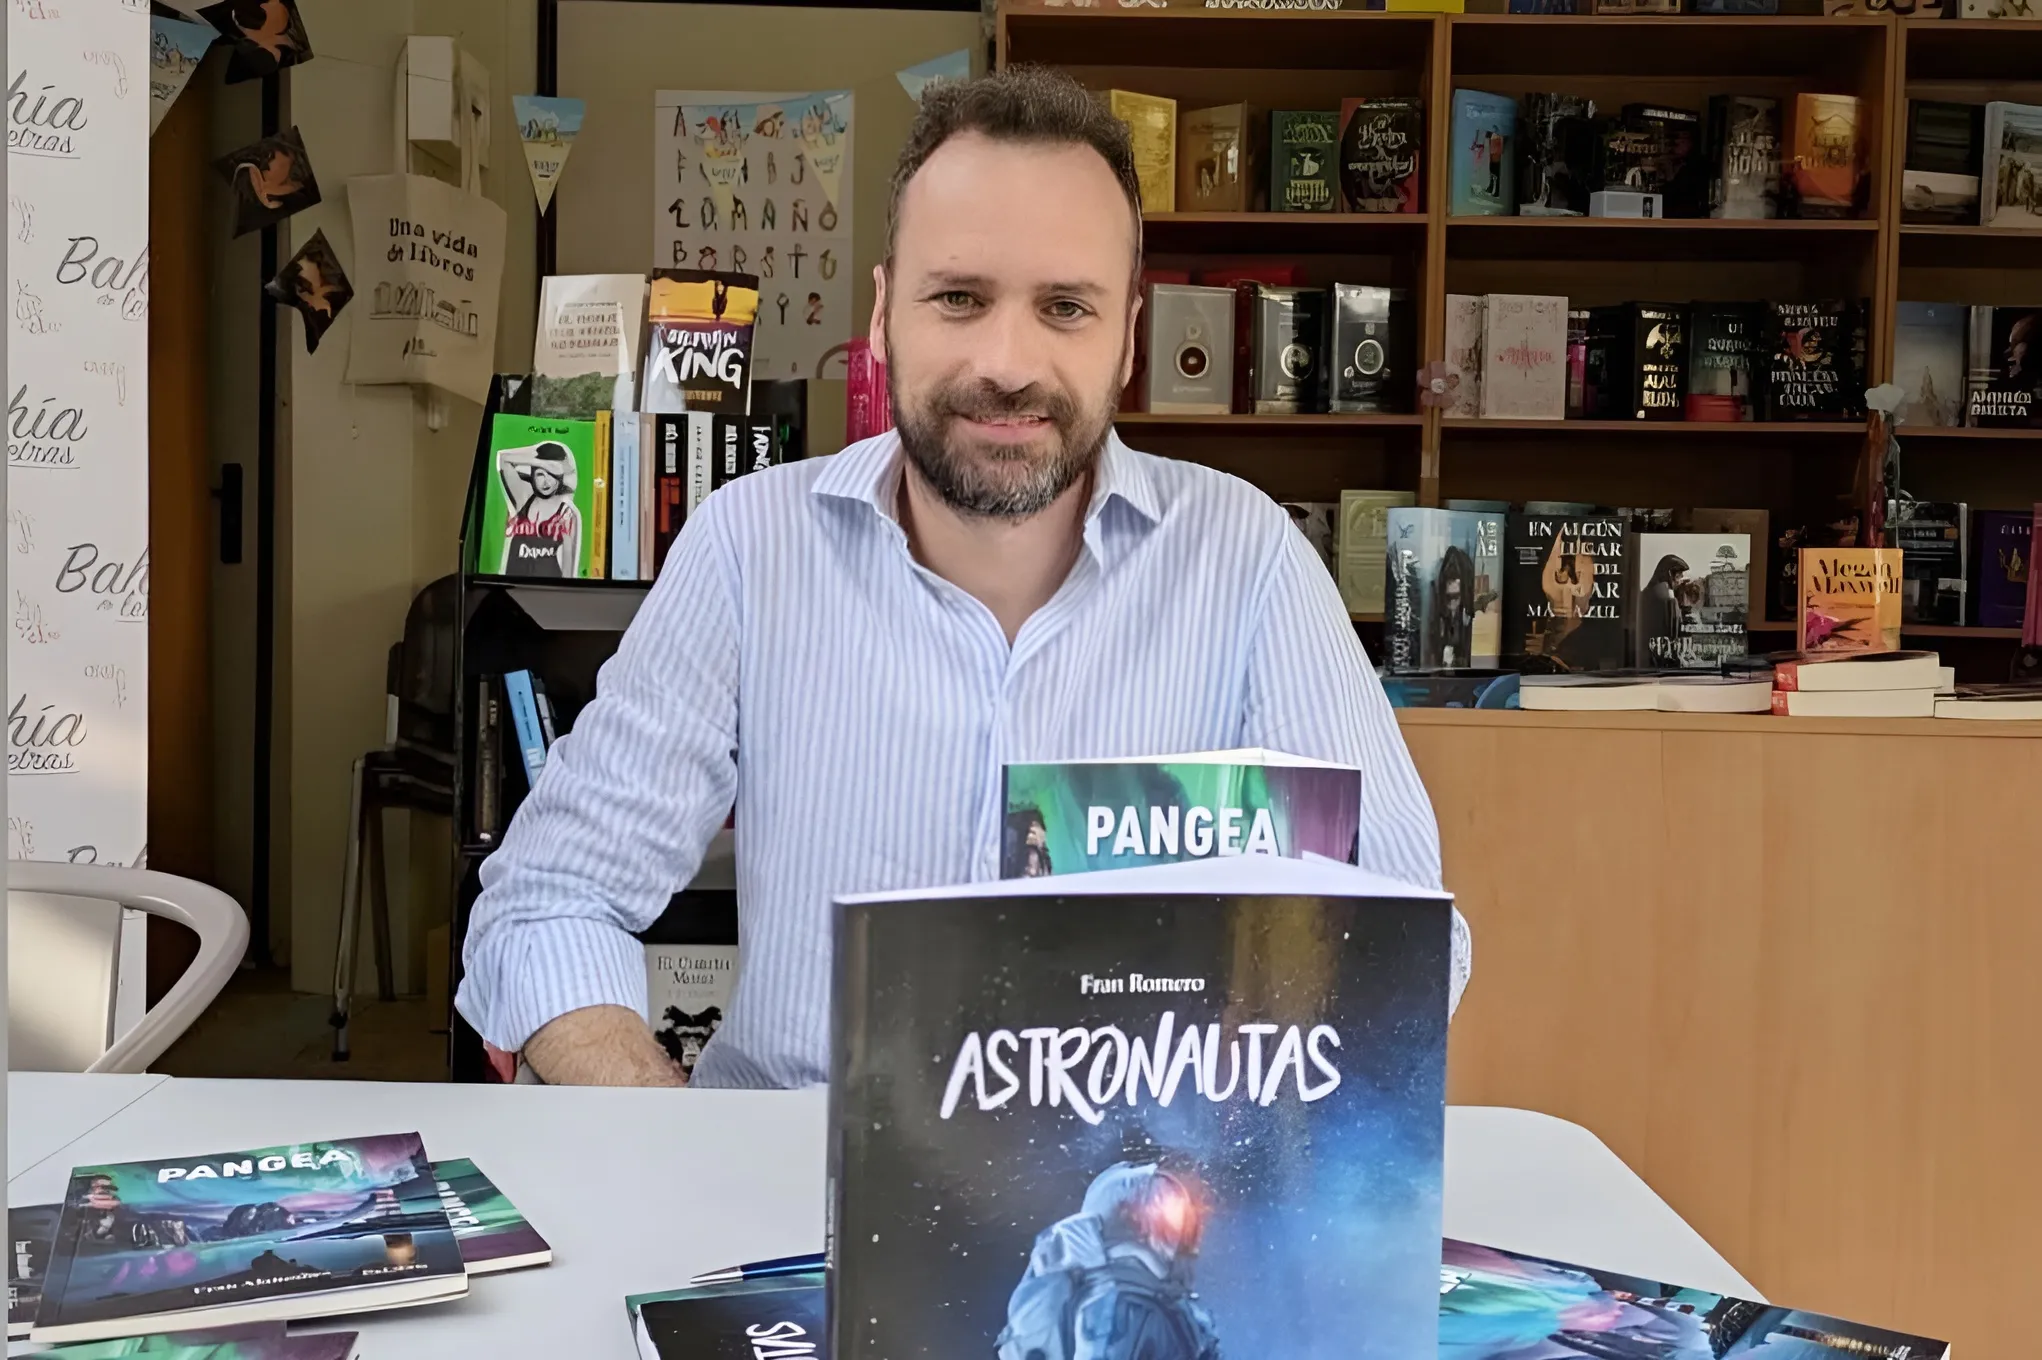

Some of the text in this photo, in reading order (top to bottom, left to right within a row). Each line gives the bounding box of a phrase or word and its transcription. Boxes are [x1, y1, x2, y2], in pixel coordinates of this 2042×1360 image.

[389, 217, 478, 258] Una vida
[410, 241, 474, 282] libros
[651, 342, 744, 390] KING
[1812, 575, 1901, 595] Maxwell
[1818, 558, 1893, 578] Megan
[1086, 804, 1280, 857] PANGEA
[1080, 972, 1205, 995] Fran Romero
[939, 1010, 1342, 1126] ASTRONAUTAS
[157, 1147, 353, 1184] PANGEA
